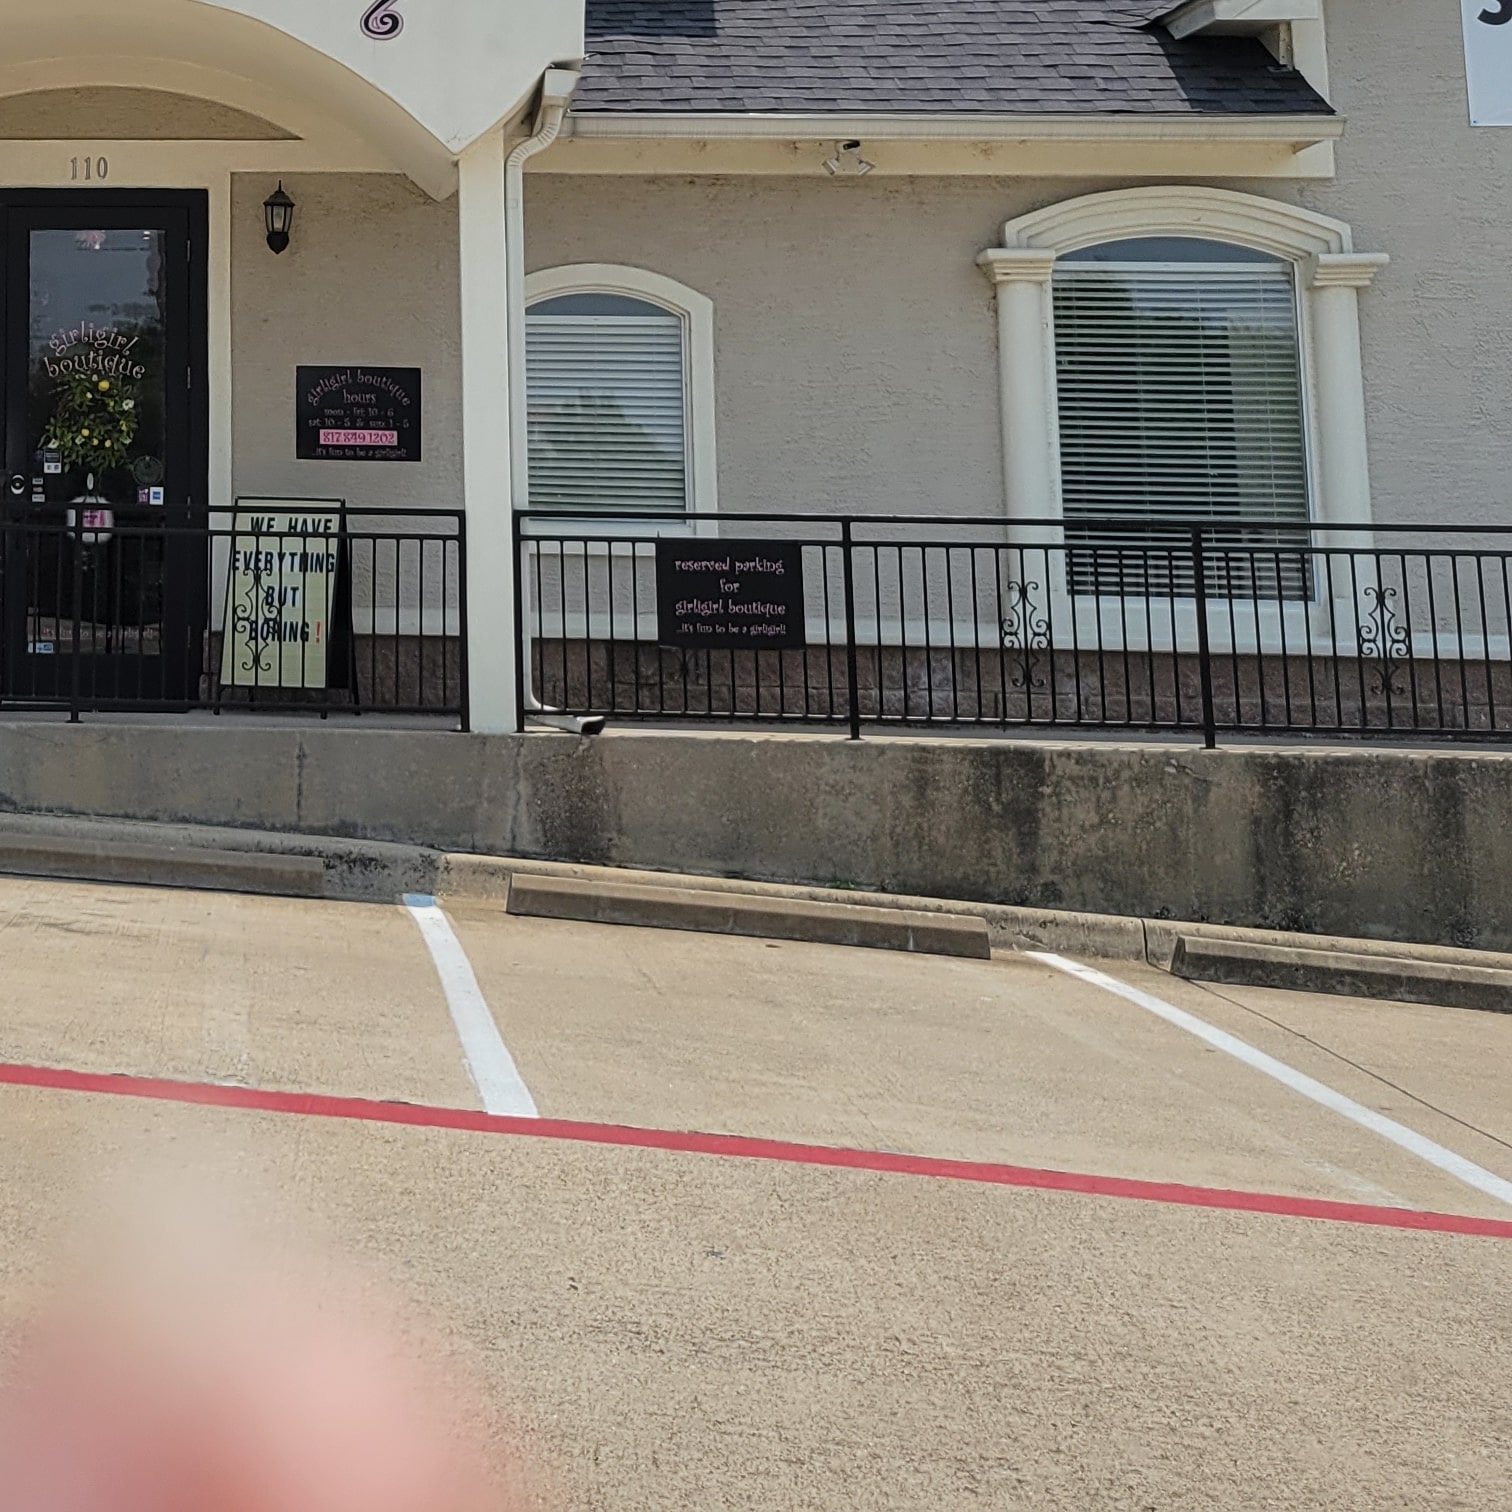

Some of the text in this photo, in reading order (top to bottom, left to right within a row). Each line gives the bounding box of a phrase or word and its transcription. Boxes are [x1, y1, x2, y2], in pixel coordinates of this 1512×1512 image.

[70, 156, 108, 180] 110
[48, 320, 139, 356] girligirl
[44, 349, 146, 379] boutique
[343, 389, 377, 404] hours
[357, 369, 411, 406] boutique
[250, 516, 333, 535] WE HAVE
[232, 550, 336, 573] EVERYTHING
[675, 556, 785, 575] reserved parking
[719, 578, 740, 593] for
[265, 586, 300, 608] BUT
[675, 599, 786, 617] girligirl boutique
[697, 622, 713, 634] fun
[715, 623, 726, 633] to
[728, 622, 739, 634] be
[742, 625, 747, 634] a
